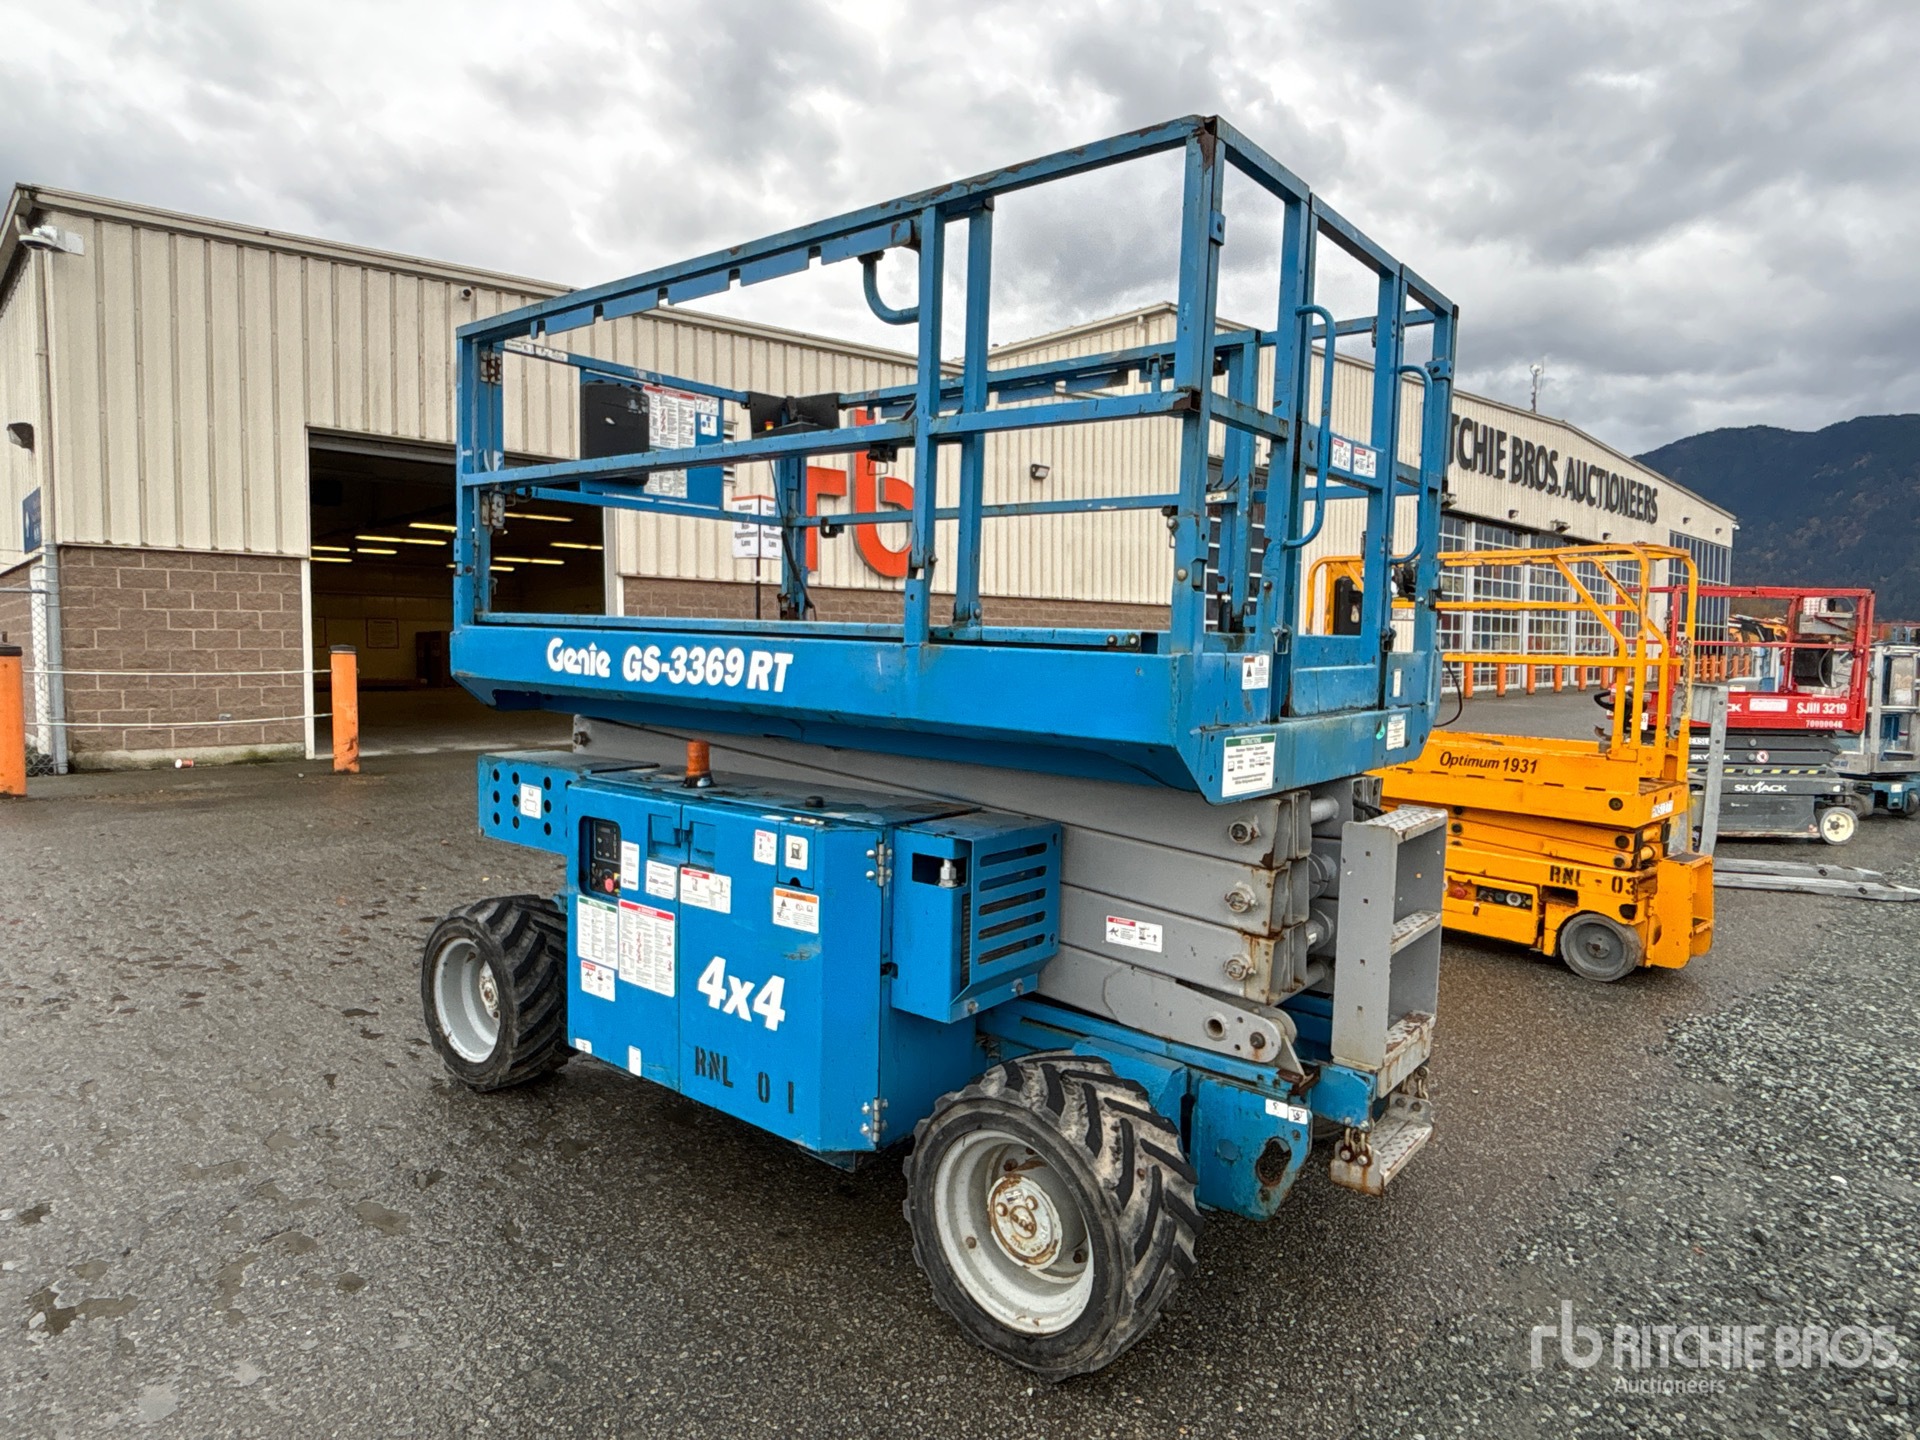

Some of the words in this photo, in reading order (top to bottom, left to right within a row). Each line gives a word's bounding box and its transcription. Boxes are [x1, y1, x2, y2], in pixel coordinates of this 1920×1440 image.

[1508, 435, 1561, 496] BROS.
[1562, 457, 1657, 525] AUCTIONEERS
[547, 637, 611, 678] Genie
[1822, 703, 1847, 714] 3219
[1440, 751, 1499, 769] Optimum
[1502, 757, 1538, 774] 1931
[1734, 781, 1787, 793] SKYJACK
[697, 956, 786, 1032] 4x4
[695, 1046, 733, 1088] RNL
